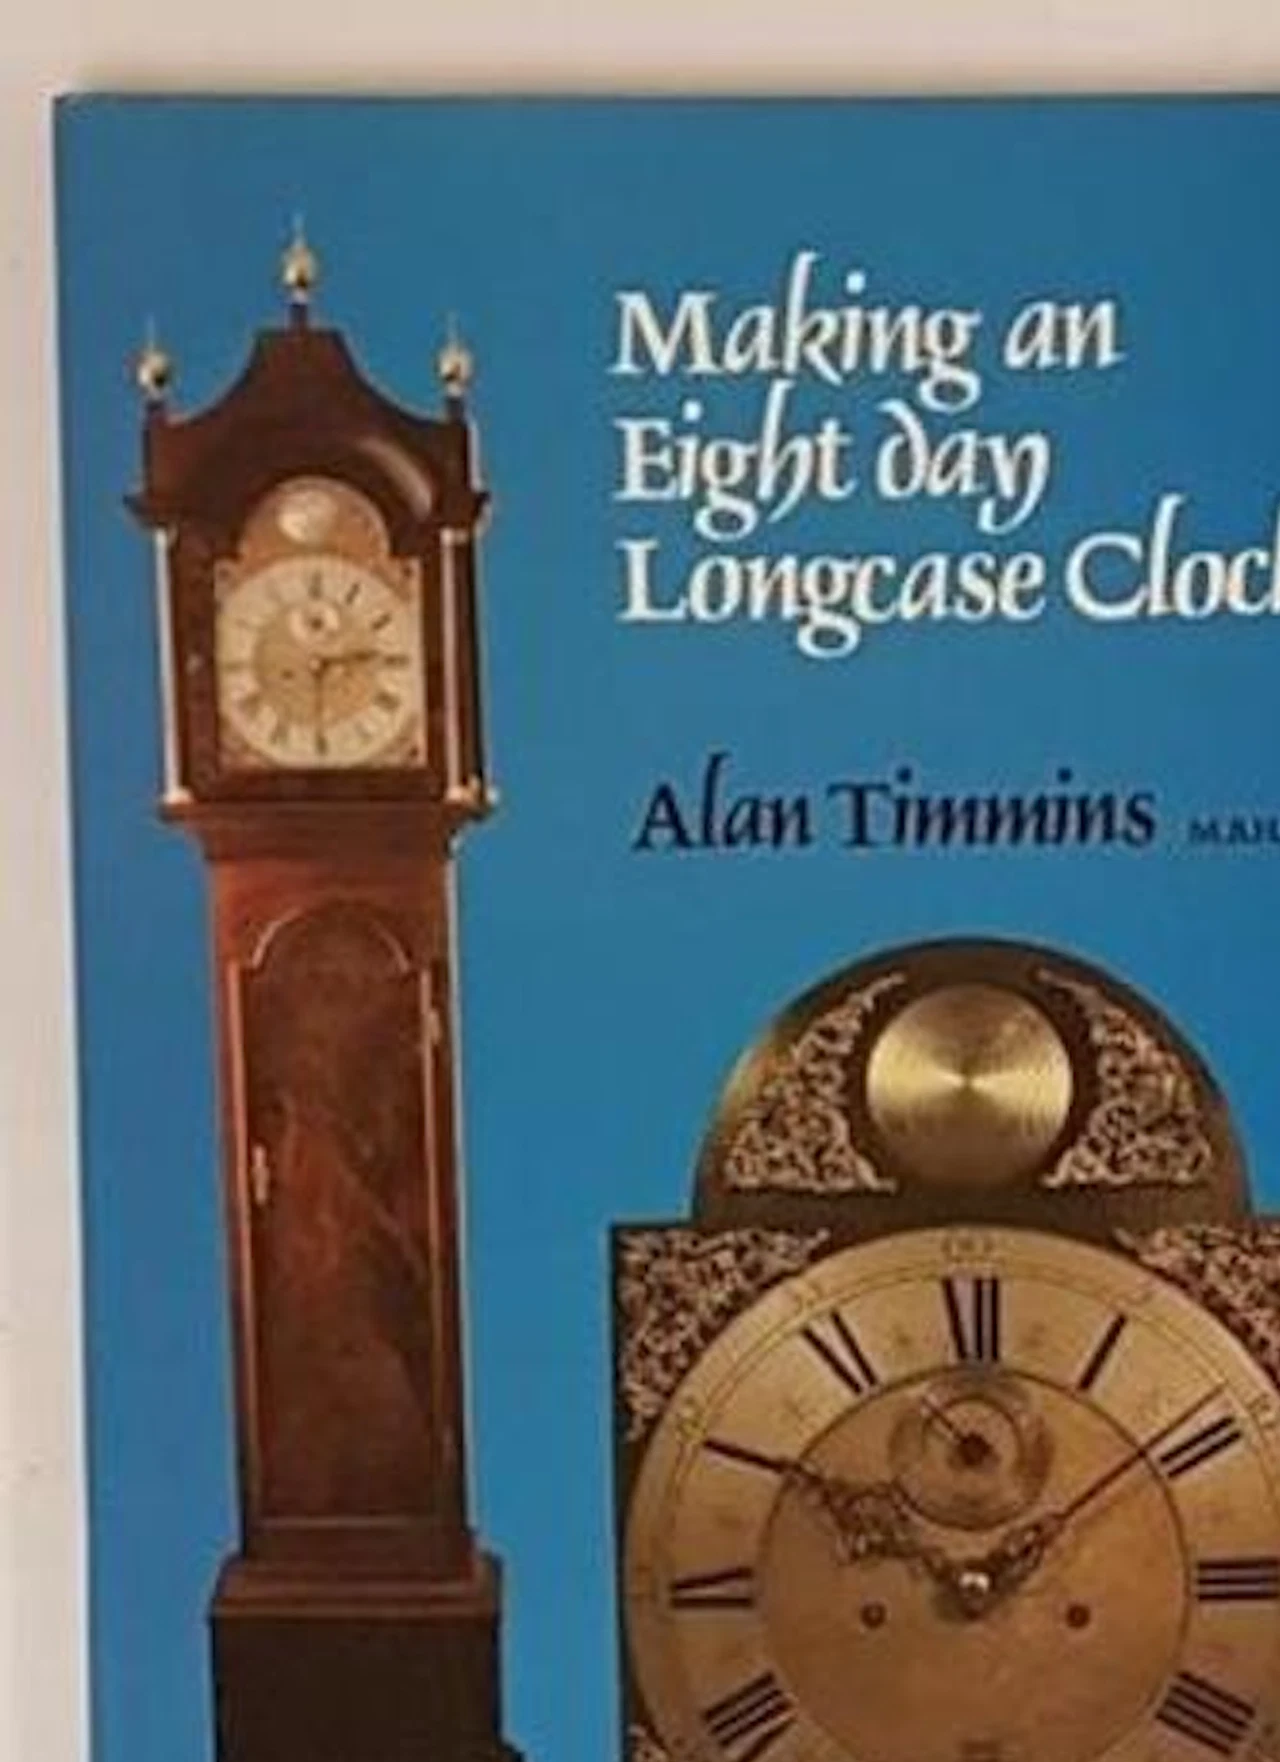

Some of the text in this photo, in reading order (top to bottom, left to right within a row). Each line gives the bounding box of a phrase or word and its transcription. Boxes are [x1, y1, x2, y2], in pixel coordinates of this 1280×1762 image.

[610, 250, 1125, 413] Making an
[614, 379, 1052, 540] Eight day
[618, 538, 1047, 660] Longcase
[631, 752, 809, 852] Alan
[827, 768, 1157, 848] Timmins
